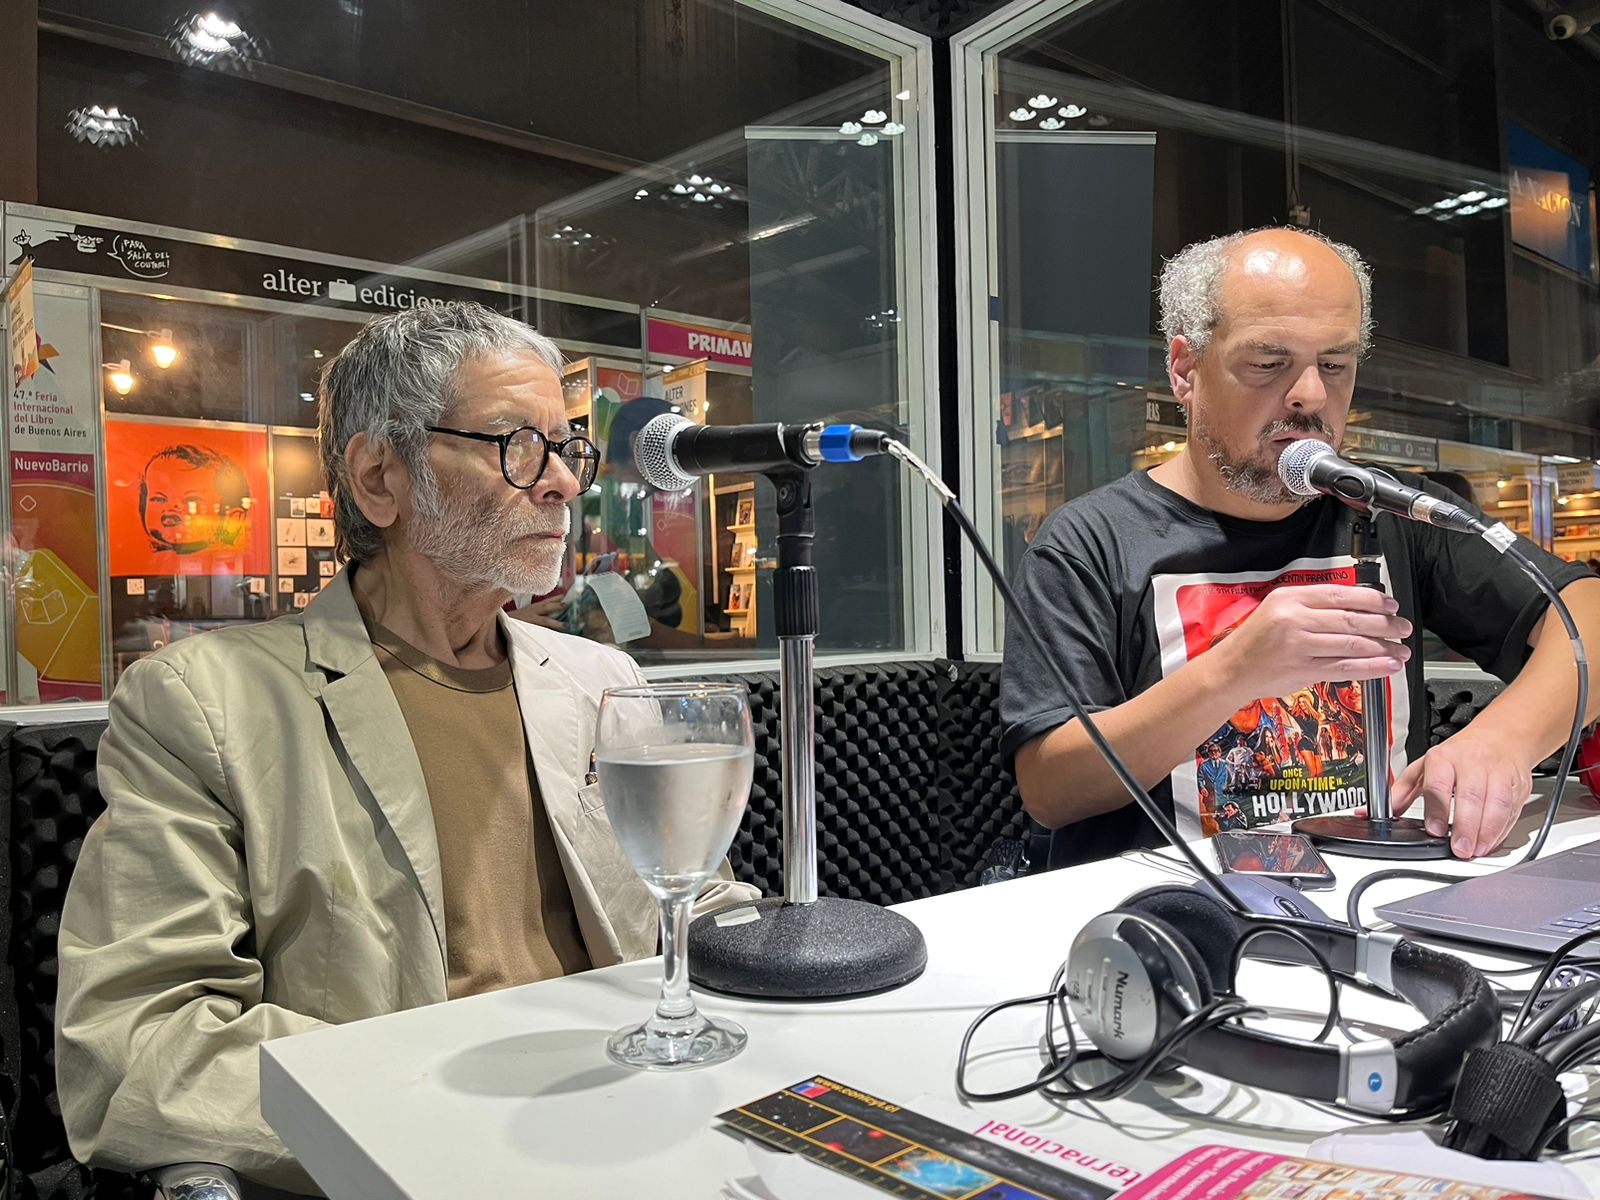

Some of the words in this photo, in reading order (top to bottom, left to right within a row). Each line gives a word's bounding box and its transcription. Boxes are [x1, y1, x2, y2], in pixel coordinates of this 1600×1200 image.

[127, 250, 152, 260] SALIR
[154, 251, 171, 259] DEL
[262, 269, 323, 297] alter
[35, 391, 58, 402] Feria
[13, 402, 73, 414] Internacional
[14, 413, 29, 423] del
[30, 414, 54, 425] Libro
[14, 424, 26, 435] de
[28, 425, 61, 437] Buenos
[63, 427, 87, 438] Aires
[15, 457, 88, 473] NuevoBarrio
[1283, 768, 1303, 779] ONCE
[1269, 778, 1300, 790] UPON
[1301, 780, 1307, 789] A
[1306, 775, 1336, 792] TIME
[1251, 786, 1367, 818] HOLLYWOOD
[1112, 970, 1130, 1041] Numark
[973, 1119, 1142, 1188] ternacional
